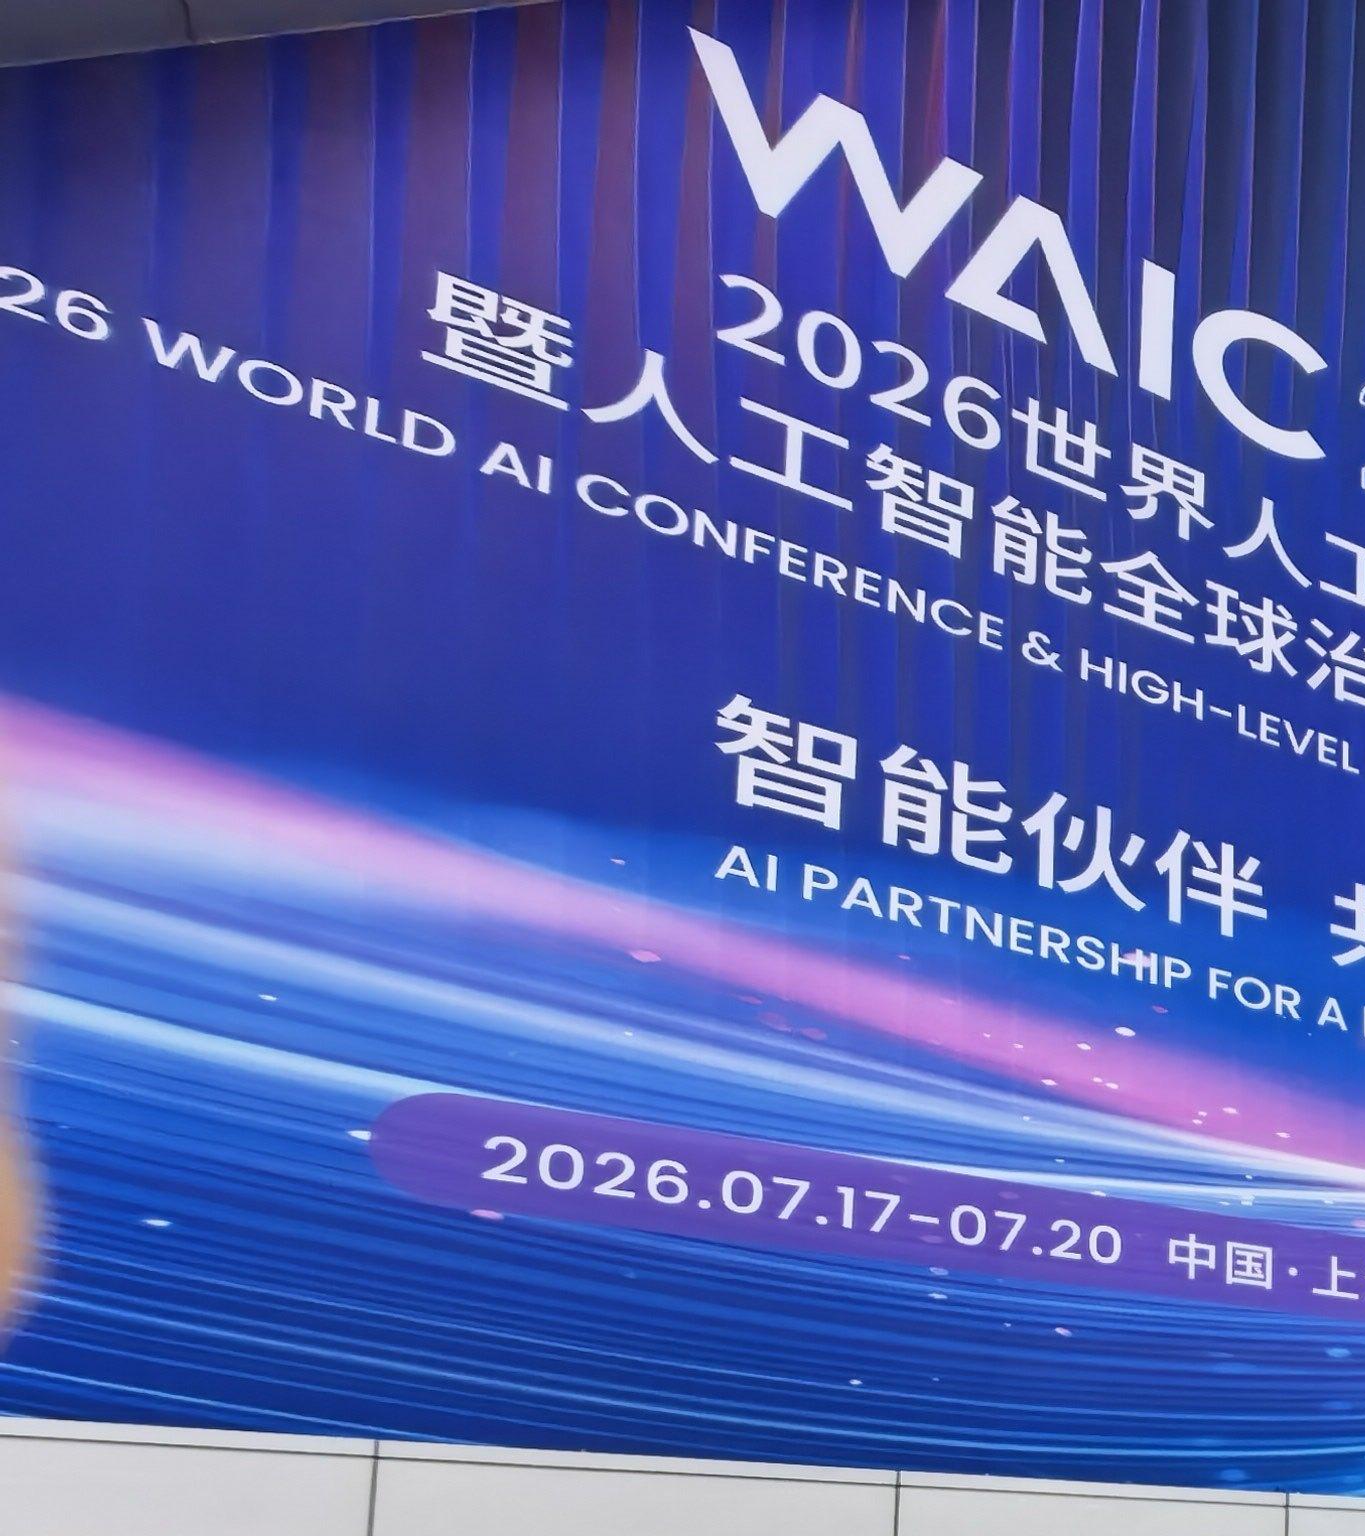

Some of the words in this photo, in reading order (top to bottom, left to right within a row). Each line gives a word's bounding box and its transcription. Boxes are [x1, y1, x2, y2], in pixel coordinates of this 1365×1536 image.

[688, 27, 1327, 459] WAIC
[142, 318, 455, 456] WORLD
[480, 443, 551, 494] AI
[577, 475, 1003, 650] CONFERENCE
[1022, 632, 1061, 671] &
[1081, 649, 1359, 773] HIGH-LEVEL
[715, 694, 1267, 937] 智能伙伴
[715, 846, 777, 891] AI
[804, 864, 1191, 988] PARTNERSHIP
[1210, 968, 1300, 1018] FOR
[1318, 998, 1347, 1030] A
[482, 1136, 1121, 1263] 2026.07.17-07.20
